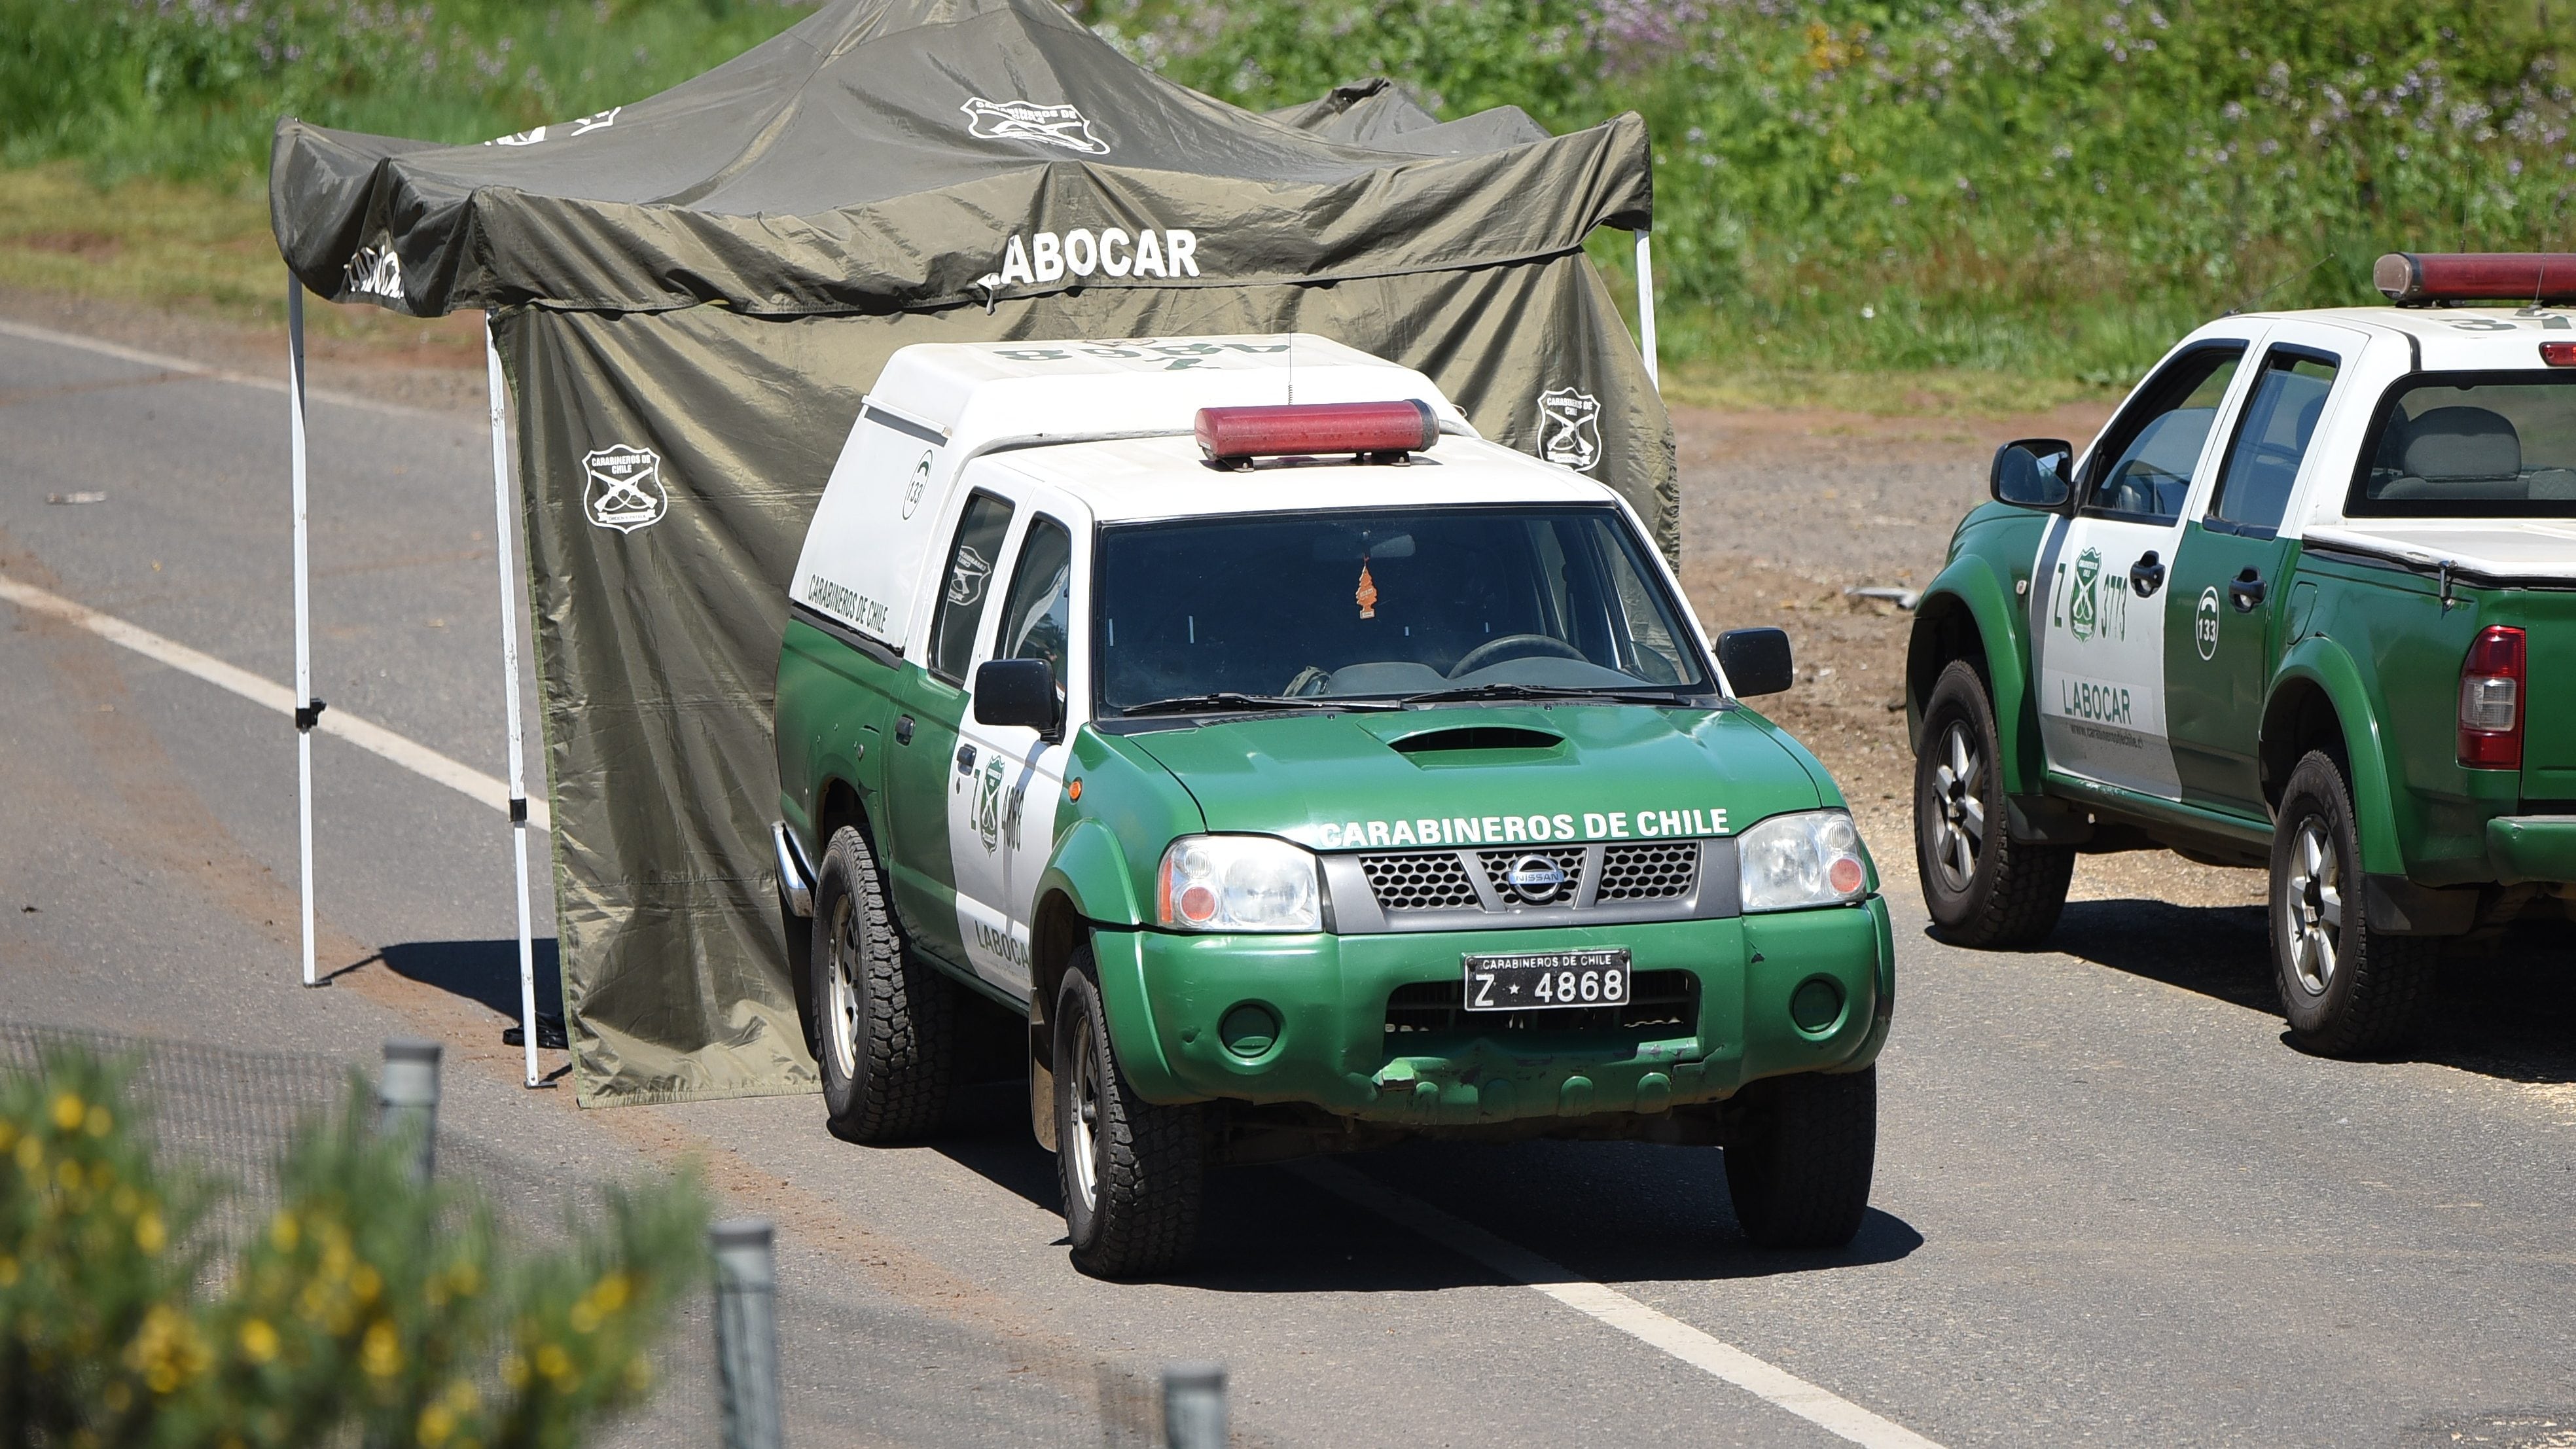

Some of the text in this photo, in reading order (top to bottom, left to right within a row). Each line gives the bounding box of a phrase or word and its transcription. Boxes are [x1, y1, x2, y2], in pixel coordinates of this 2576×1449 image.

[1583, 401, 1593, 410] DE
[592, 454, 651, 467] CARABINEROS DE
[611, 465, 632, 474] CHILE
[907, 480, 923, 504] 133
[808, 573, 888, 634] CARABINEROS DE CHILE
[2054, 563, 2067, 628] Z
[2101, 573, 2128, 643] 3773
[2198, 618, 2216, 643] 133
[2062, 679, 2132, 725] LABOCAR
[971, 768, 981, 831] Z
[1319, 808, 1730, 848] CARABINEROS DE CHILE
[1516, 873, 1559, 882] NISSAN
[975, 920, 1031, 968] LABOCA
[1482, 954, 1612, 970] CARABINEROS DE CHILE
[1475, 969, 1623, 1007] Z 4868
